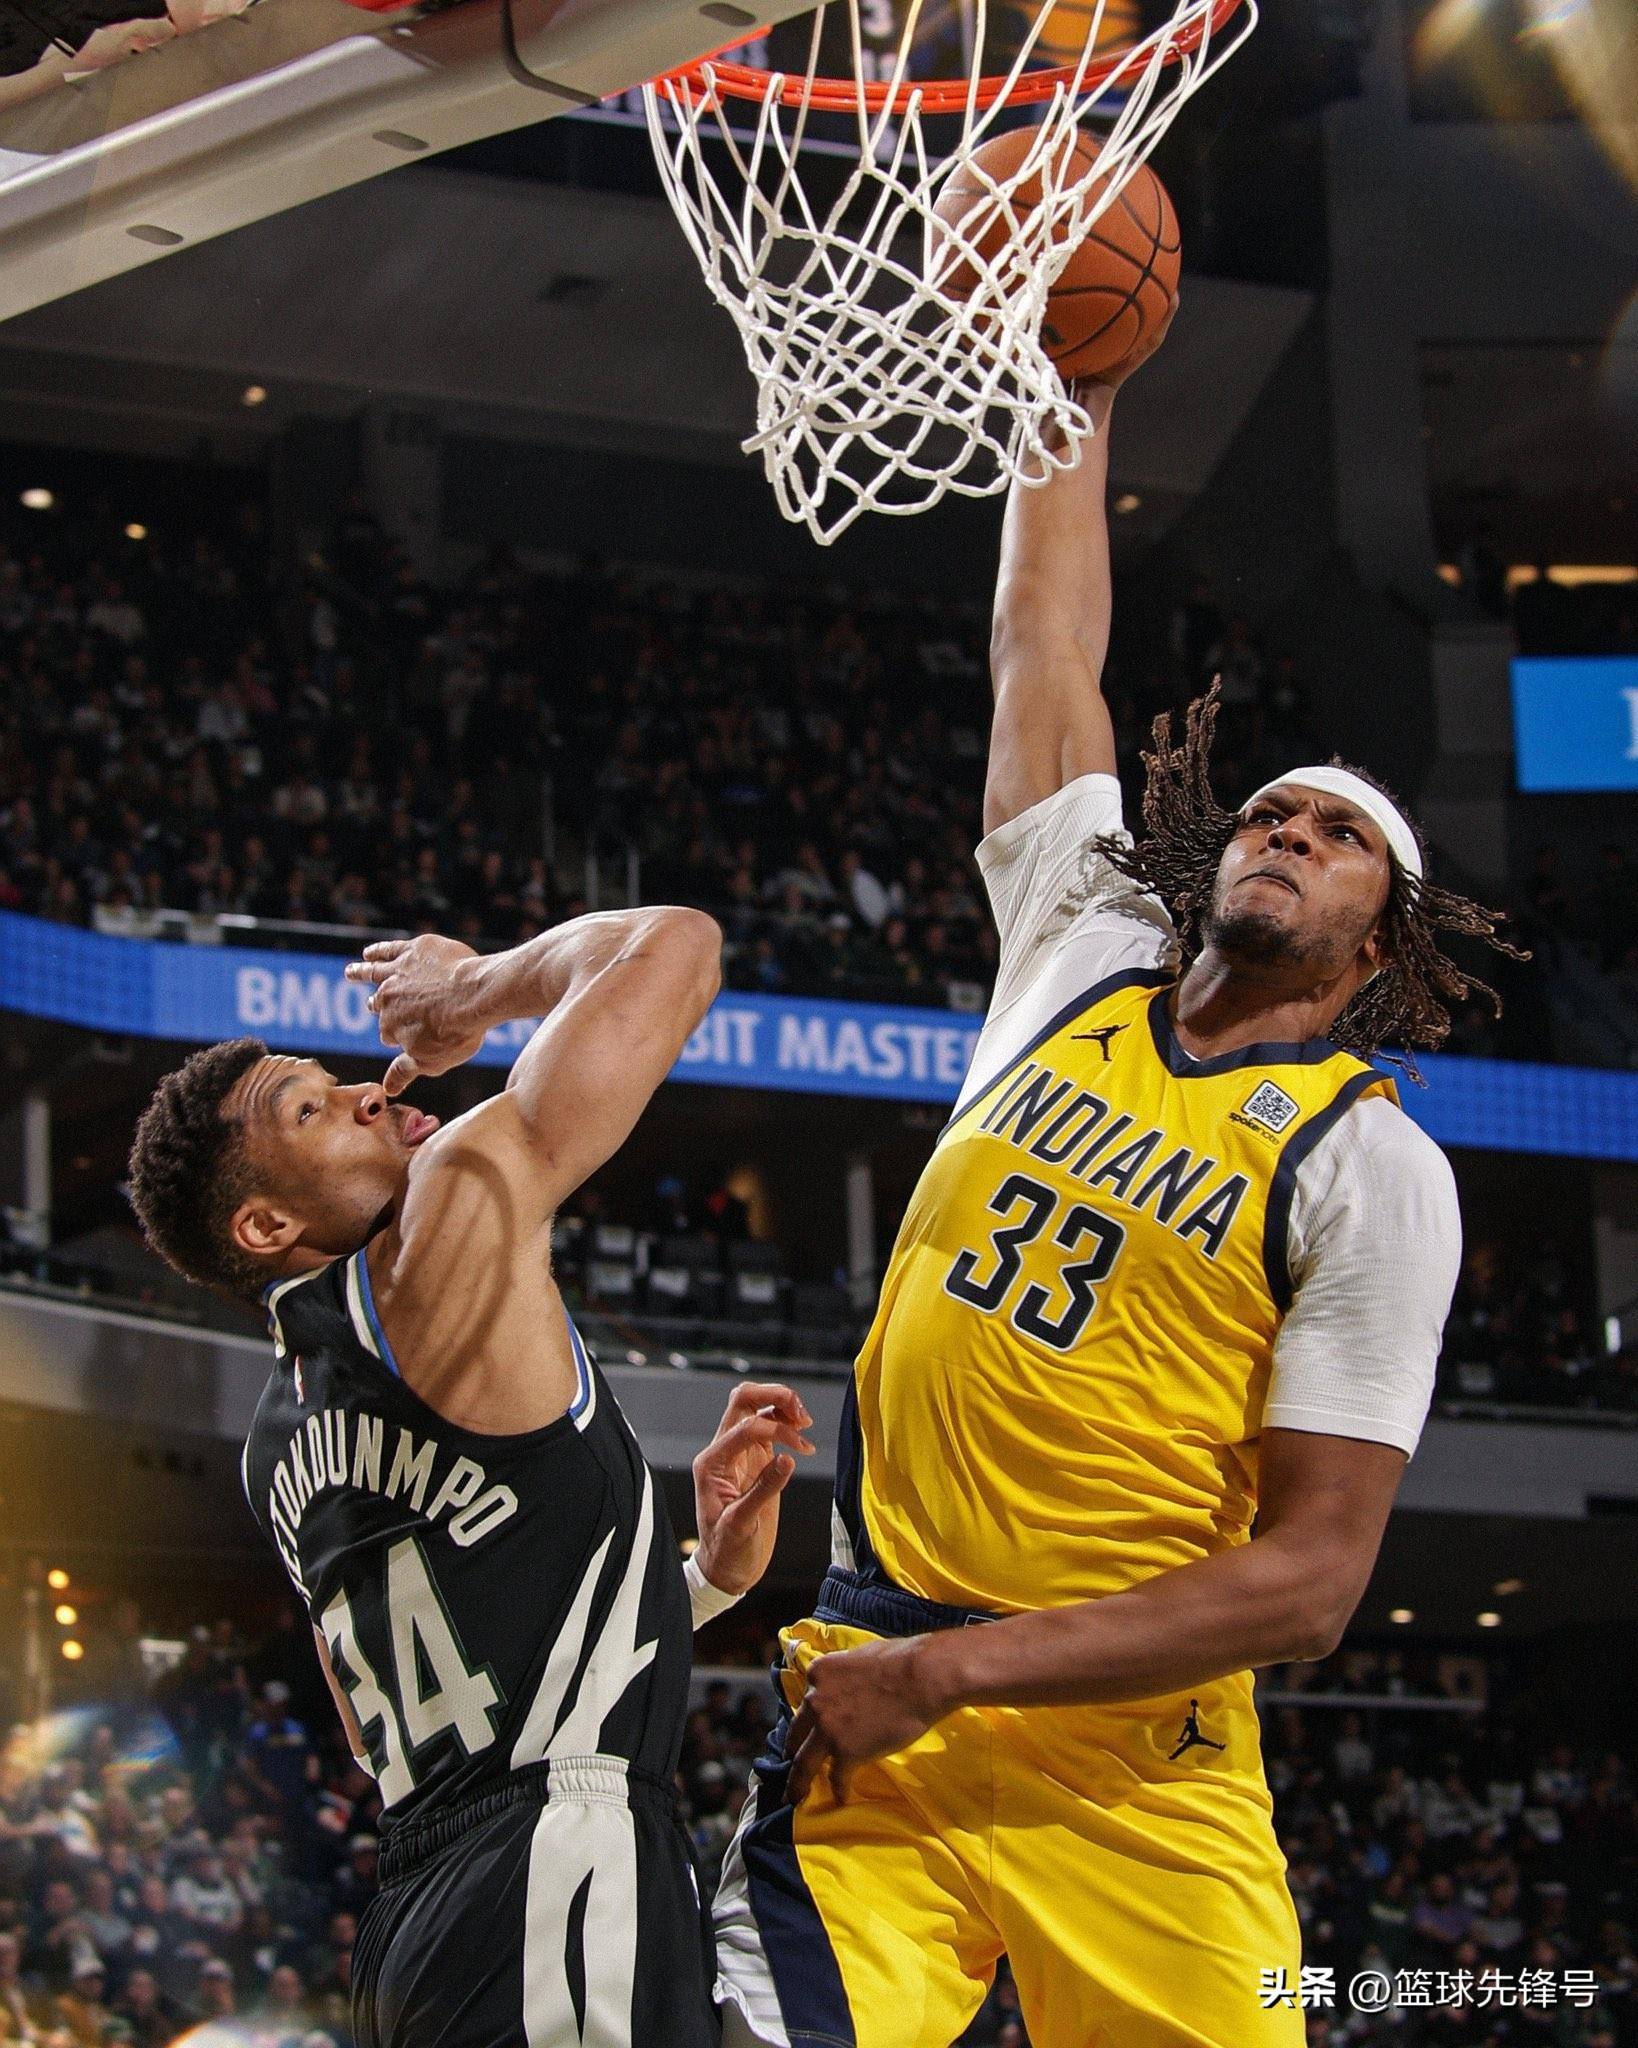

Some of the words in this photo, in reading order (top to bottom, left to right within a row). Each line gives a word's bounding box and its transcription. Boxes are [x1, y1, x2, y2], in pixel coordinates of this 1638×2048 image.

[236, 966, 374, 1034] BMO
[977, 1062, 1251, 1261] INDIANA
[943, 1171, 1127, 1353] 33
[313, 1531, 507, 1809] 34
